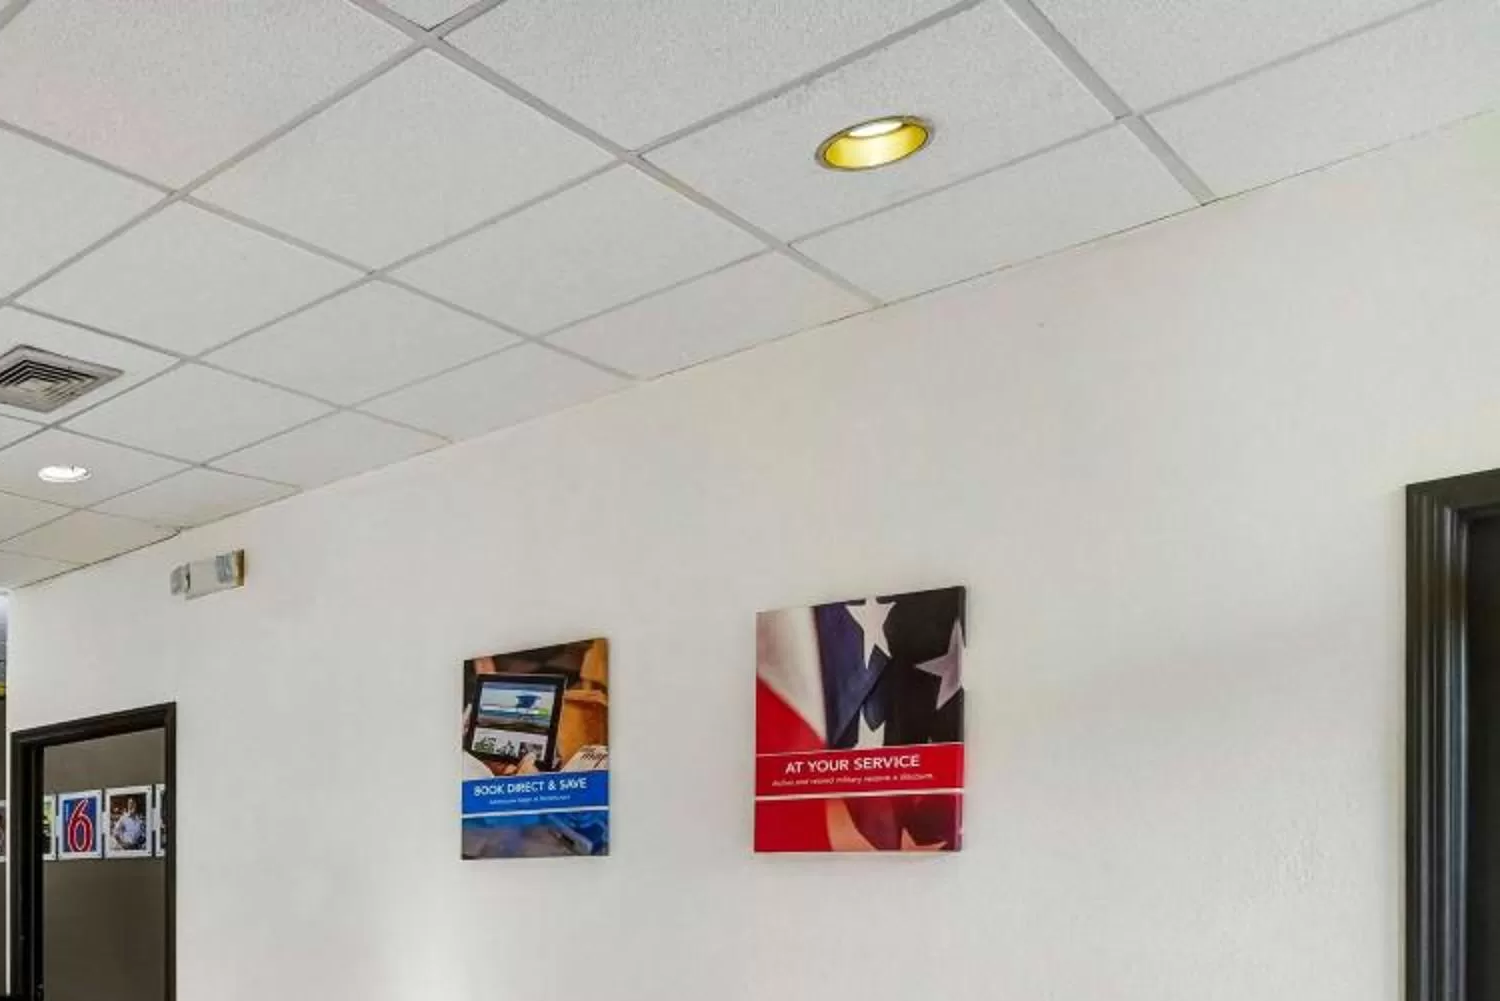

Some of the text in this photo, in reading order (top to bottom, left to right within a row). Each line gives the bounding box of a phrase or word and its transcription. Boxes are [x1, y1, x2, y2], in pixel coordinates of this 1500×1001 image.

[785, 754, 921, 775] AT YOUR SERVICE
[473, 778, 588, 797] BOOK DIRECT & SAVE
[68, 798, 93, 853] 6
